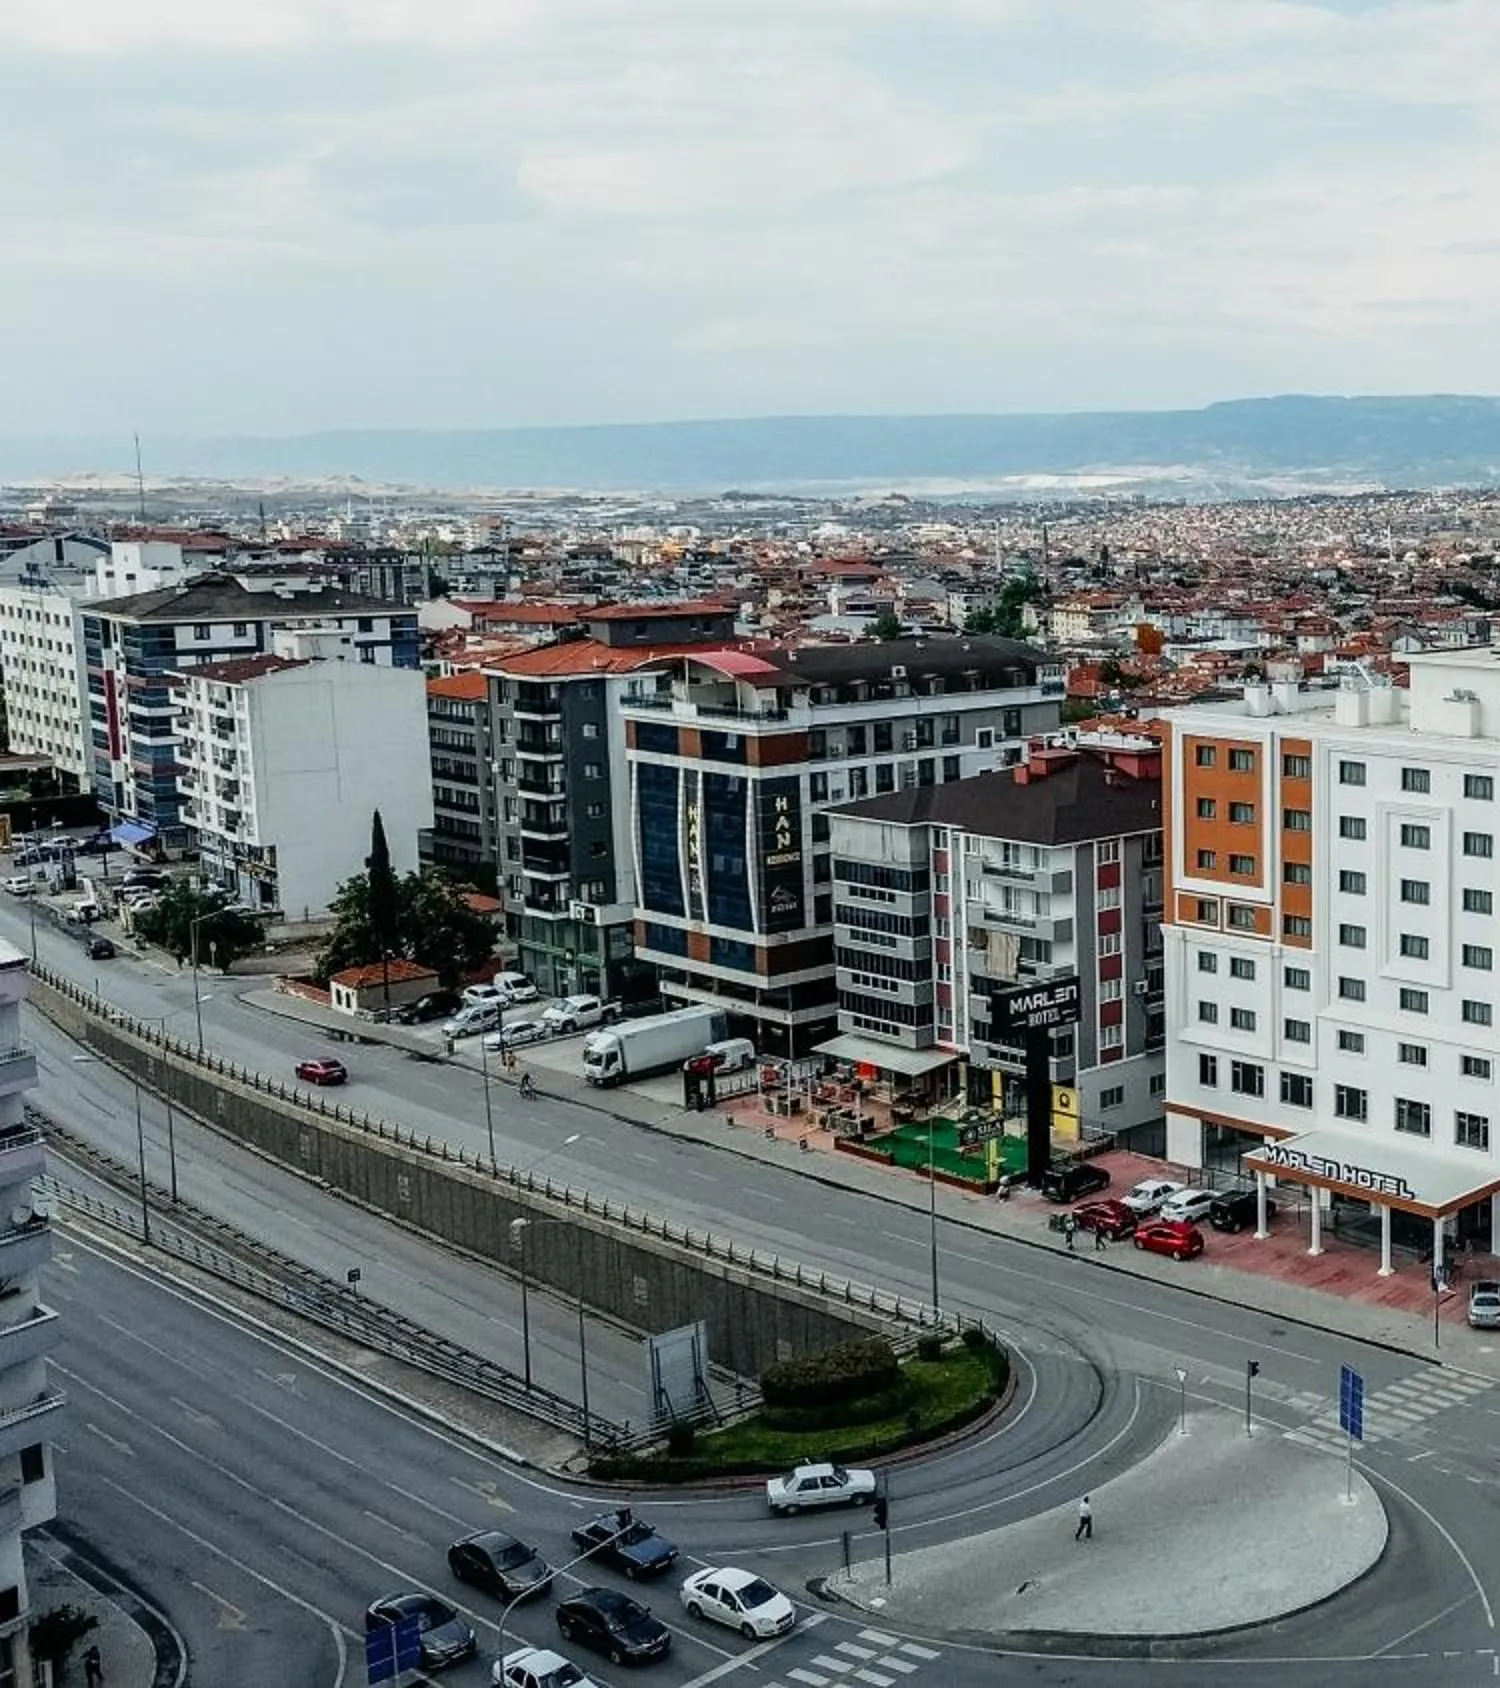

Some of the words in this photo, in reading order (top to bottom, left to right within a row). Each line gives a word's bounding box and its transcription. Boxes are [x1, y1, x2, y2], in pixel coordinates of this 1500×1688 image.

[775, 796, 791, 849] HAN
[1009, 985, 1077, 1014] MARLEN
[1264, 1145, 1342, 1182] MARLEN
[1341, 1164, 1415, 1200] HOTEL
